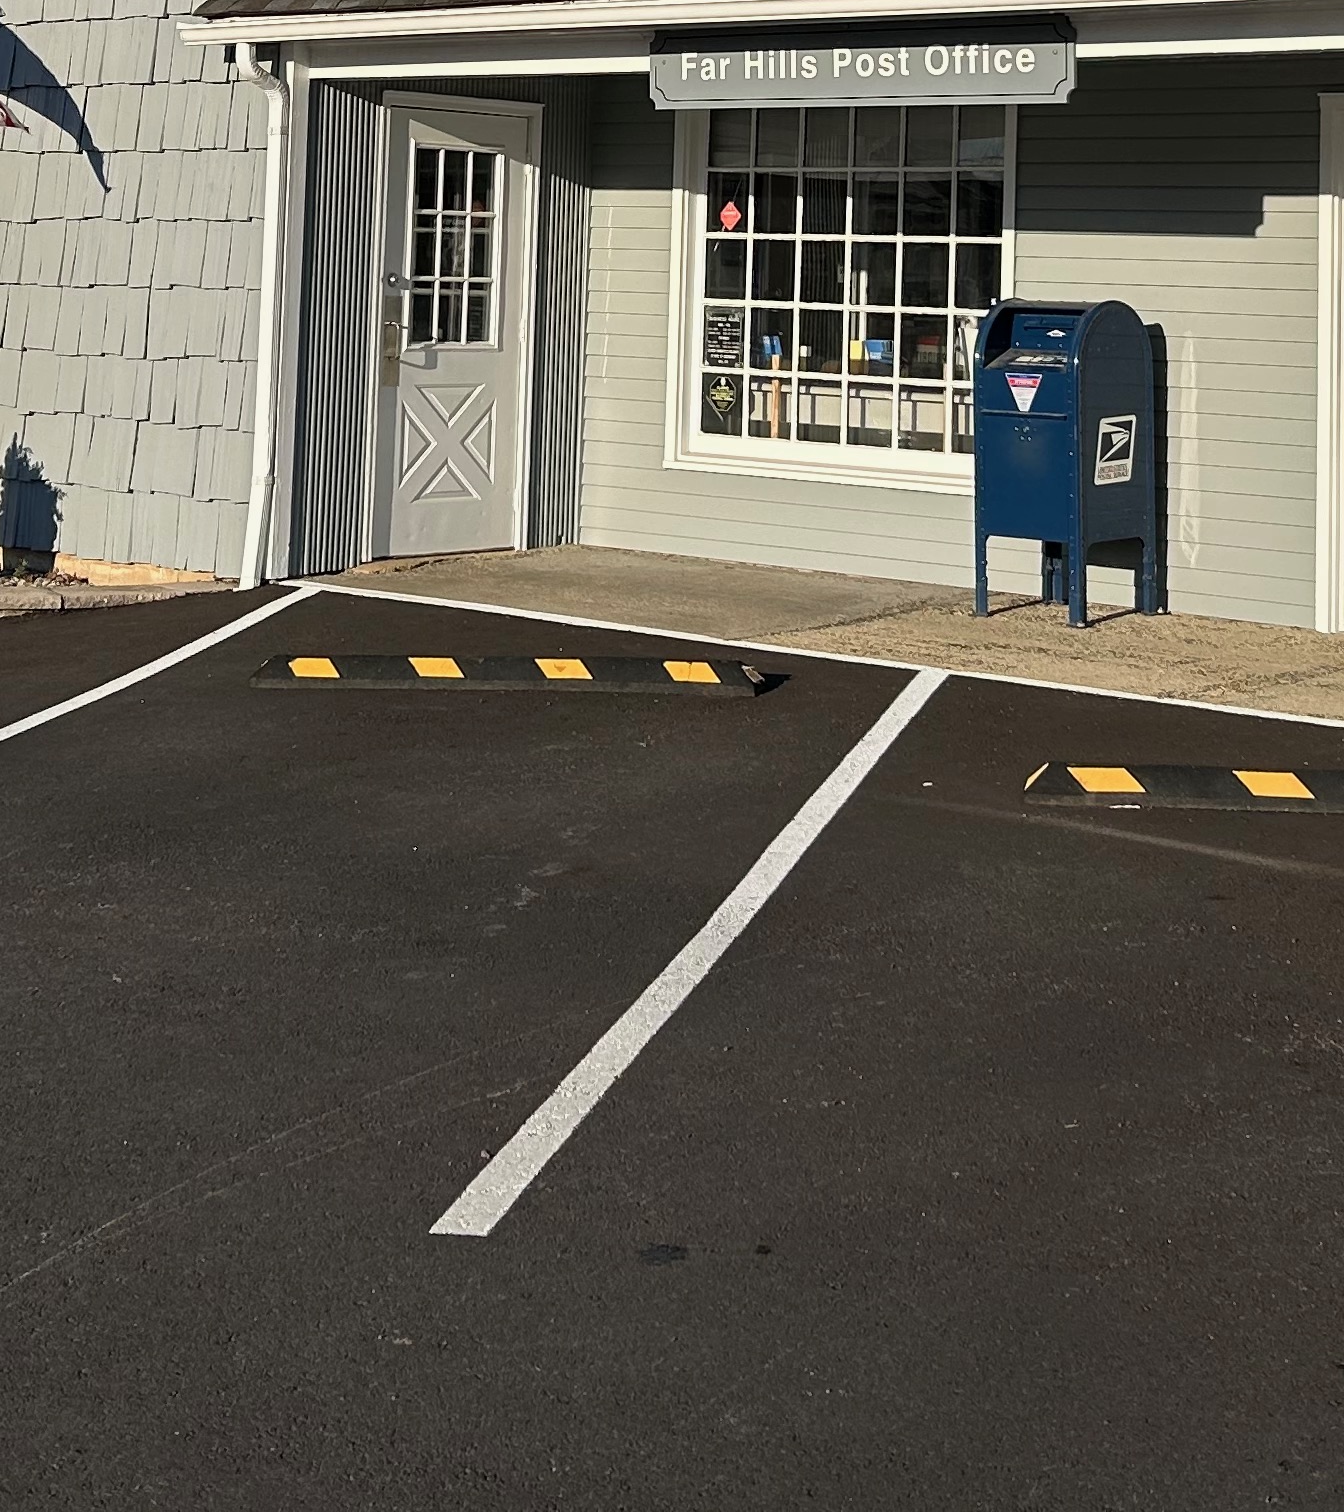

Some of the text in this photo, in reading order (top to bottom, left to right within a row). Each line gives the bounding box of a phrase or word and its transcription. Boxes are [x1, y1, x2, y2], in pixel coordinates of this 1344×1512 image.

[680, 43, 1036, 81] Far Hills Post Office
